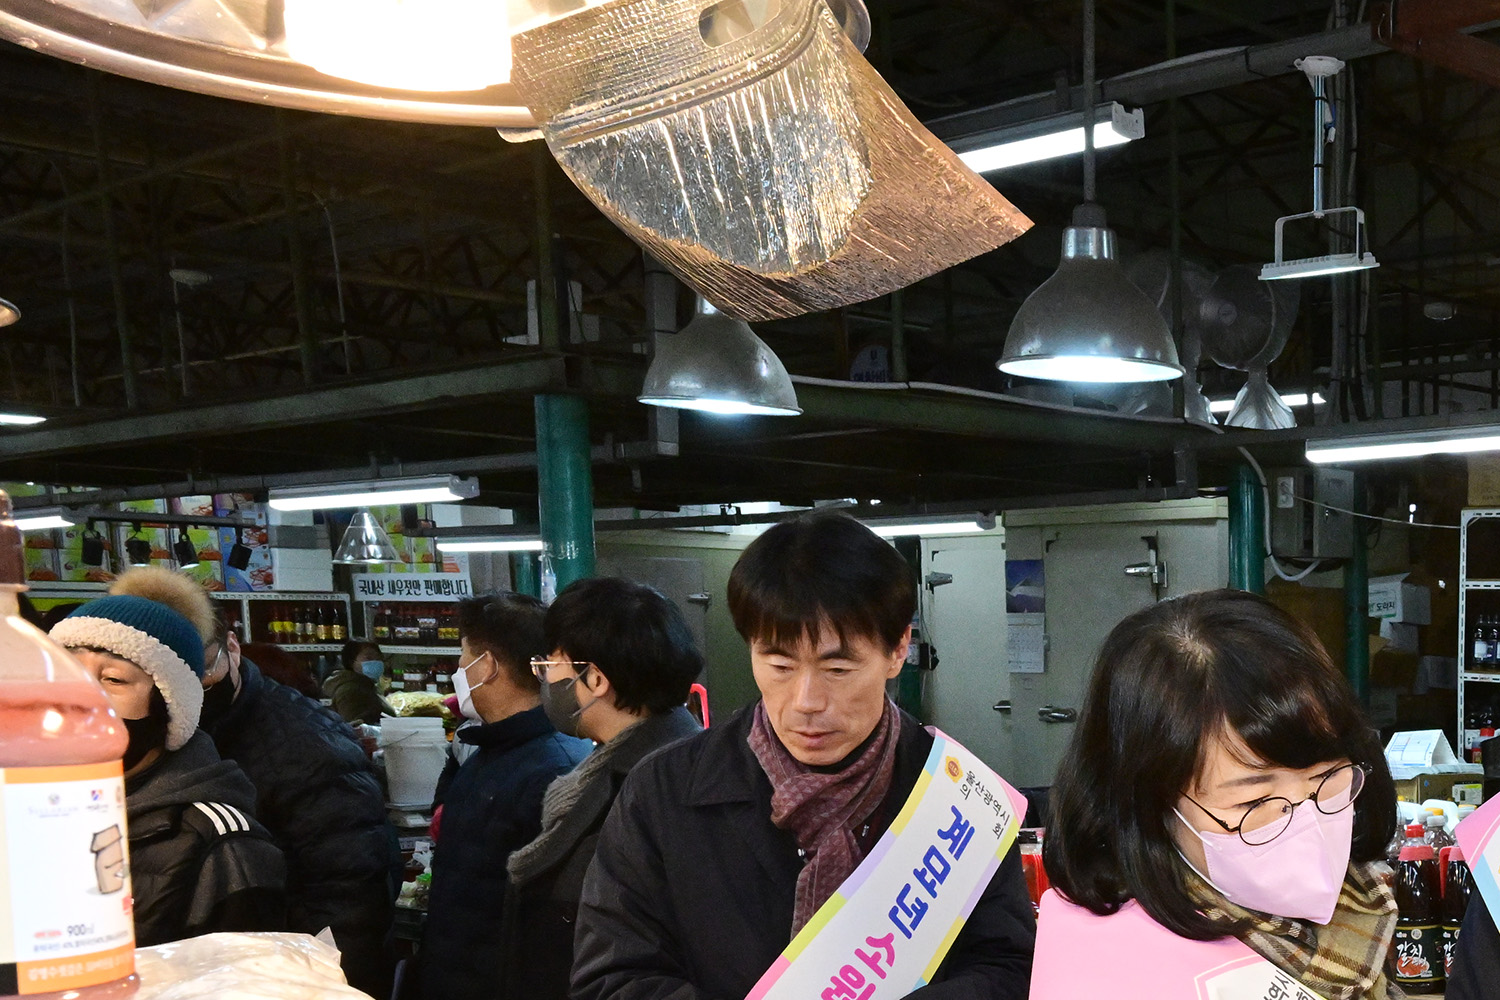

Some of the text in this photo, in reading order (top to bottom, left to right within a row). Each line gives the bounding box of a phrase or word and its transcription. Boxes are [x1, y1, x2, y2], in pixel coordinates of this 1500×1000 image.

[358, 579, 468, 597] 국내산 새우젓만 판매합니다
[966, 770, 1010, 826] 울산광역시
[887, 804, 976, 940] 계묘년
[1396, 941, 1423, 968] 갈치
[1443, 941, 1457, 968] 갈
